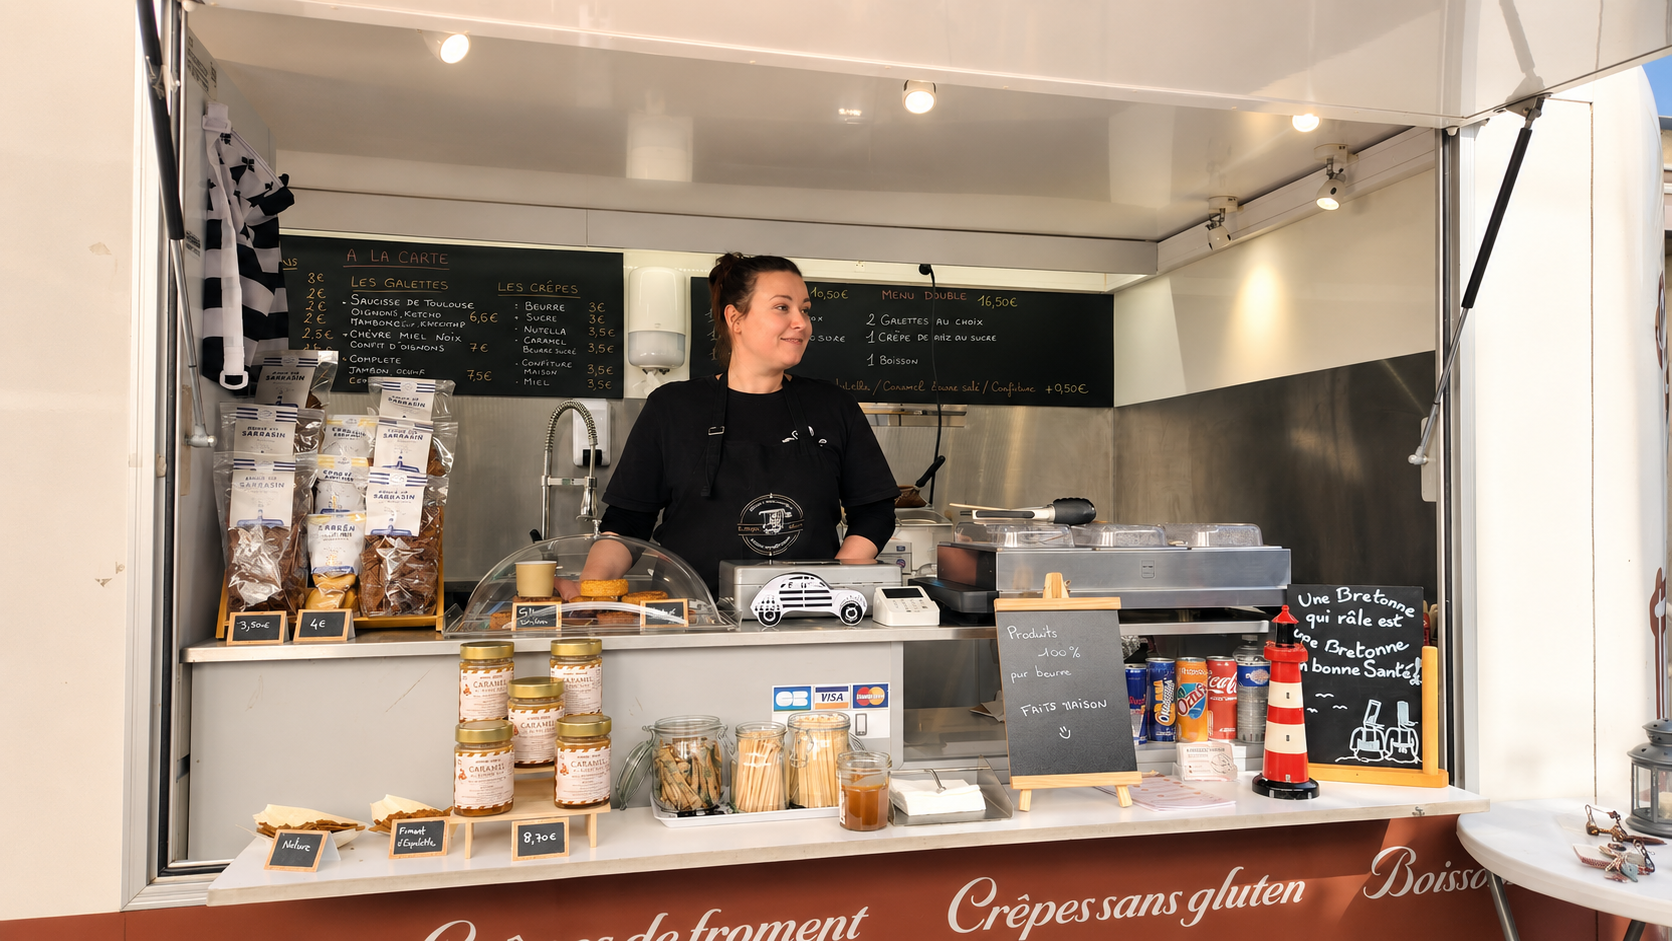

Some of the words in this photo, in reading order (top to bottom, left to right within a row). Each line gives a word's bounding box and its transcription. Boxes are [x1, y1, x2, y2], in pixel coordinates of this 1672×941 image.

[346, 248, 357, 263] A
[371, 249, 390, 263] LA
[398, 250, 449, 265] CARTE
[351, 276, 377, 288] LES
[384, 278, 449, 290] GALETTES
[497, 281, 524, 292] LES
[530, 280, 579, 294] CRÊPES
[305, 288, 327, 300] 2€
[810, 287, 849, 300] 10,50€
[881, 289, 915, 300] MENU
[925, 290, 967, 301] DOUBLE
[977, 295, 1018, 309] 16,50€
[305, 301, 327, 312] 2€
[350, 293, 400, 306] SAUCISSE
[407, 299, 419, 307] DE
[424, 299, 474, 310] TOULOUSE
[525, 301, 565, 312] BEURRE
[588, 301, 606, 313] 3€
[303, 313, 327, 325] 2€
[526, 312, 557, 322] SUCRE
[588, 314, 606, 325] 3€
[866, 313, 876, 326] 2
[880, 313, 930, 326] GALETTES
[936, 317, 949, 326] AU
[400, 331, 427, 341] MIEL
[524, 325, 567, 336] NUTELLA
[588, 327, 616, 339] 3,5€
[866, 330, 875, 344] 1
[917, 334, 929, 342] DE
[524, 336, 567, 346] CARAMEL
[469, 343, 489, 354] 7€
[588, 343, 614, 354] 3,5€
[866, 353, 875, 367] 1
[467, 369, 492, 382] 7,5€
[587, 364, 613, 377] 3,5€
[524, 378, 550, 386] MIEL
[587, 379, 612, 391] 3,5€
[1298, 592, 1330, 607] Une
[1335, 586, 1415, 618] Bretonne
[310, 618, 326, 630] 4€
[1305, 609, 1331, 629] qui
[1337, 608, 1373, 627] râle
[1378, 613, 1404, 628] est
[1007, 625, 1058, 640] Produits
[1324, 639, 1410, 659] Bretonne
[1010, 670, 1028, 683] pur
[1034, 664, 1072, 678] beurre
[1311, 657, 1361, 676] bonne
[821, 693, 844, 702] VISA
[523, 832, 557, 846] 8,70€
[948, 876, 1095, 941] Crêpes
[1096, 890, 1183, 921] sans
[1180, 866, 1306, 928] gluten
[690, 906, 869, 941] froment
